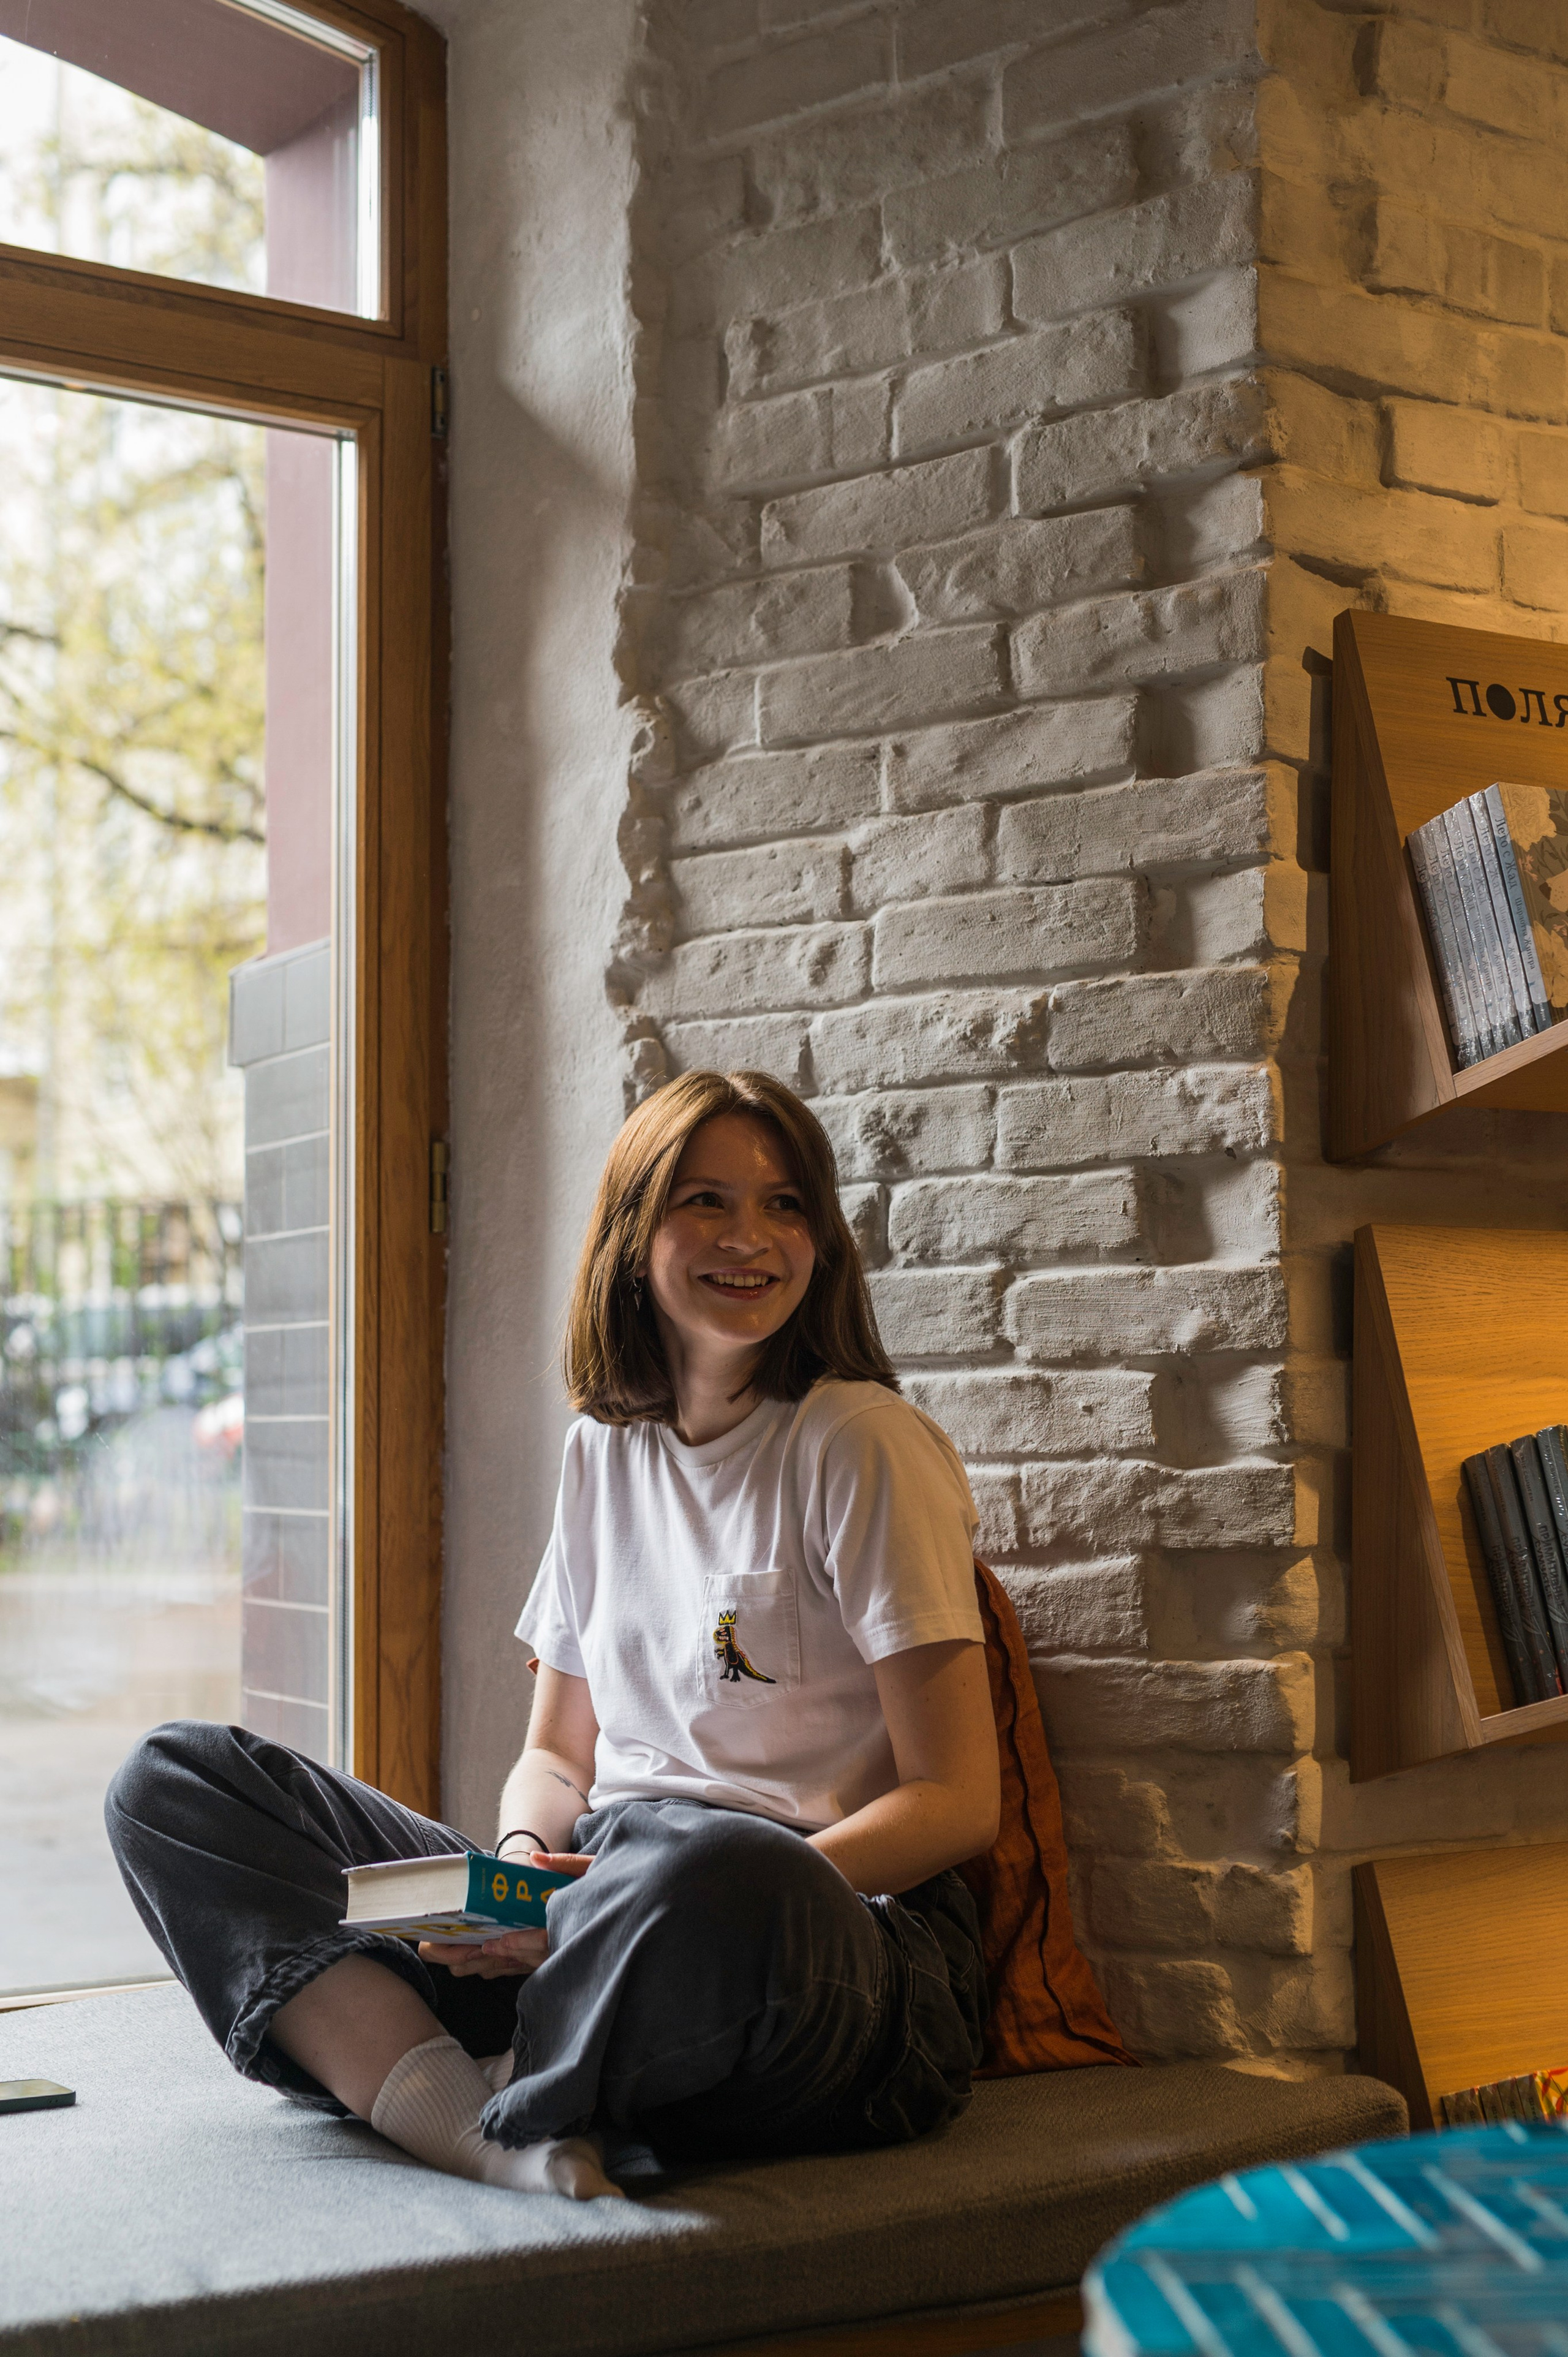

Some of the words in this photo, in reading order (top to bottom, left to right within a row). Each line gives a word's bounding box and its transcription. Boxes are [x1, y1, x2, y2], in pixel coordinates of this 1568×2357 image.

[1454, 841, 1466, 871] Лето
[1465, 834, 1477, 863] Лето
[1479, 827, 1491, 856] Лето
[1495, 818, 1509, 847] Лето
[1506, 860, 1517, 890] Жад
[1429, 856, 1441, 886] Лето
[1441, 850, 1452, 879] Лето
[1450, 890, 1461, 918] Жад
[1515, 898, 1528, 936] Шарлотта
[1524, 939, 1536, 969] Жингра
[1469, 966, 1480, 998] Жингра
[1482, 959, 1493, 991] Жингра
